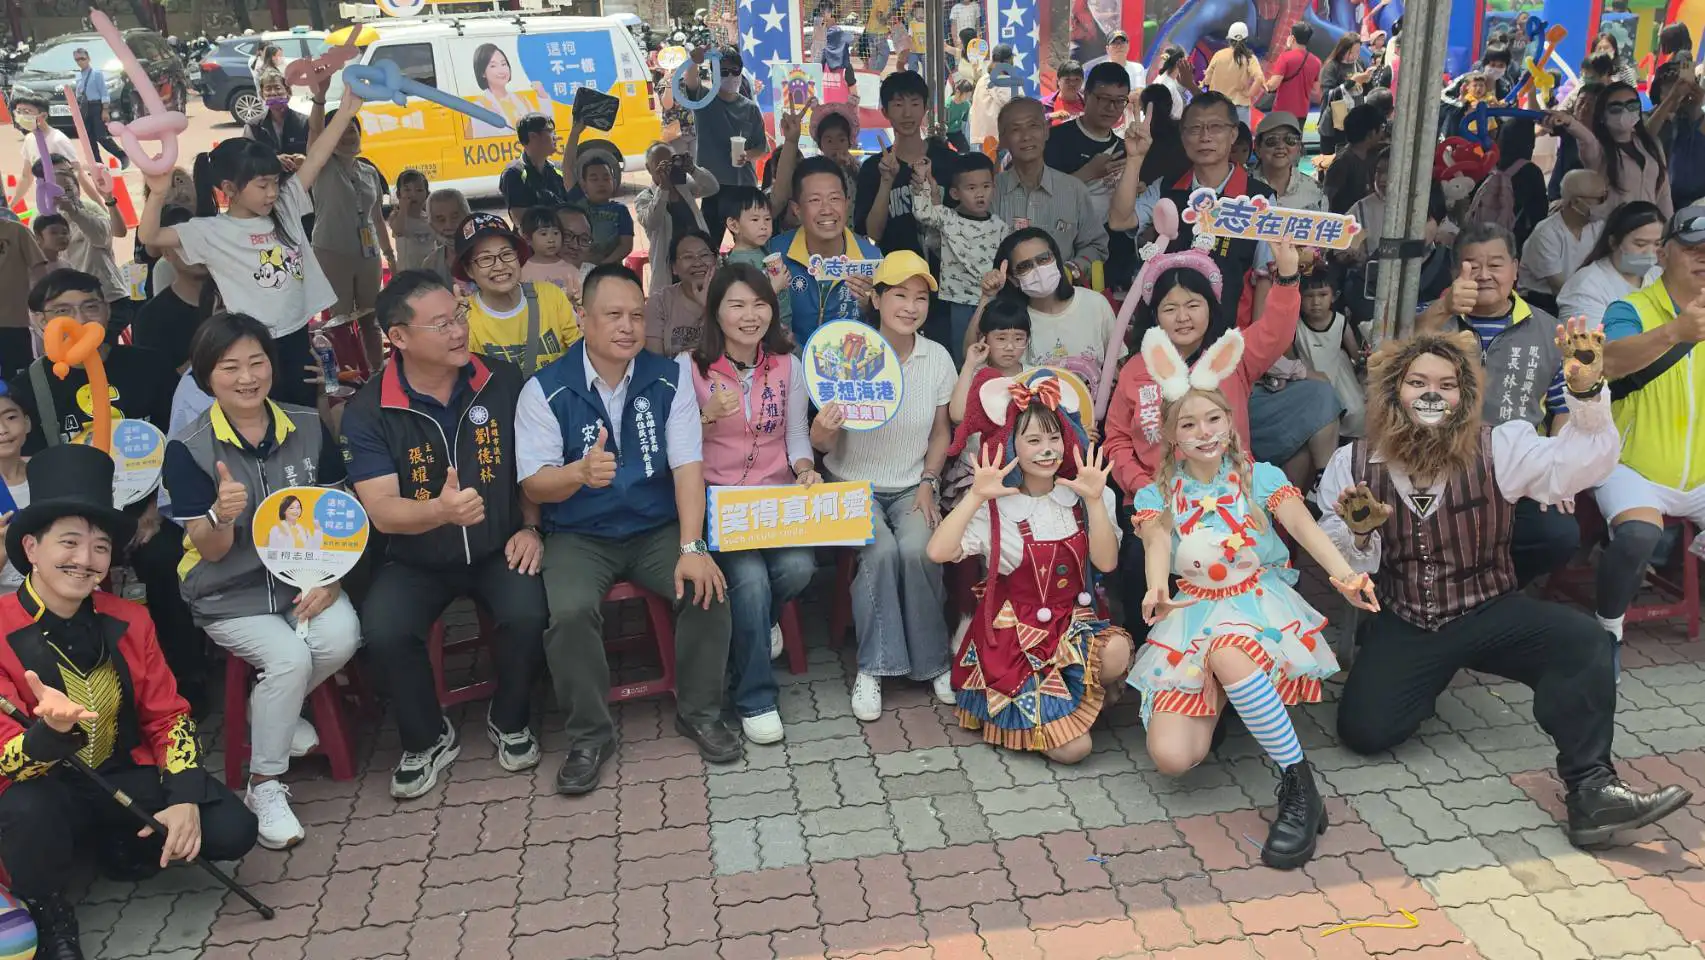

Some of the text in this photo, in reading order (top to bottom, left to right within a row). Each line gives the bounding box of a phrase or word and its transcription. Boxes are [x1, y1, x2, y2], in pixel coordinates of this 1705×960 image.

[546, 40, 577, 57] 這柯
[549, 57, 596, 76] 不一樣
[1213, 200, 1344, 243] 志在陪伴
[825, 258, 879, 277] 志在陪
[816, 380, 896, 402] 夢想海港
[475, 426, 496, 484] 劉德林
[408, 446, 432, 502] 張耀倫
[721, 488, 868, 535] 笑得真柯愛
